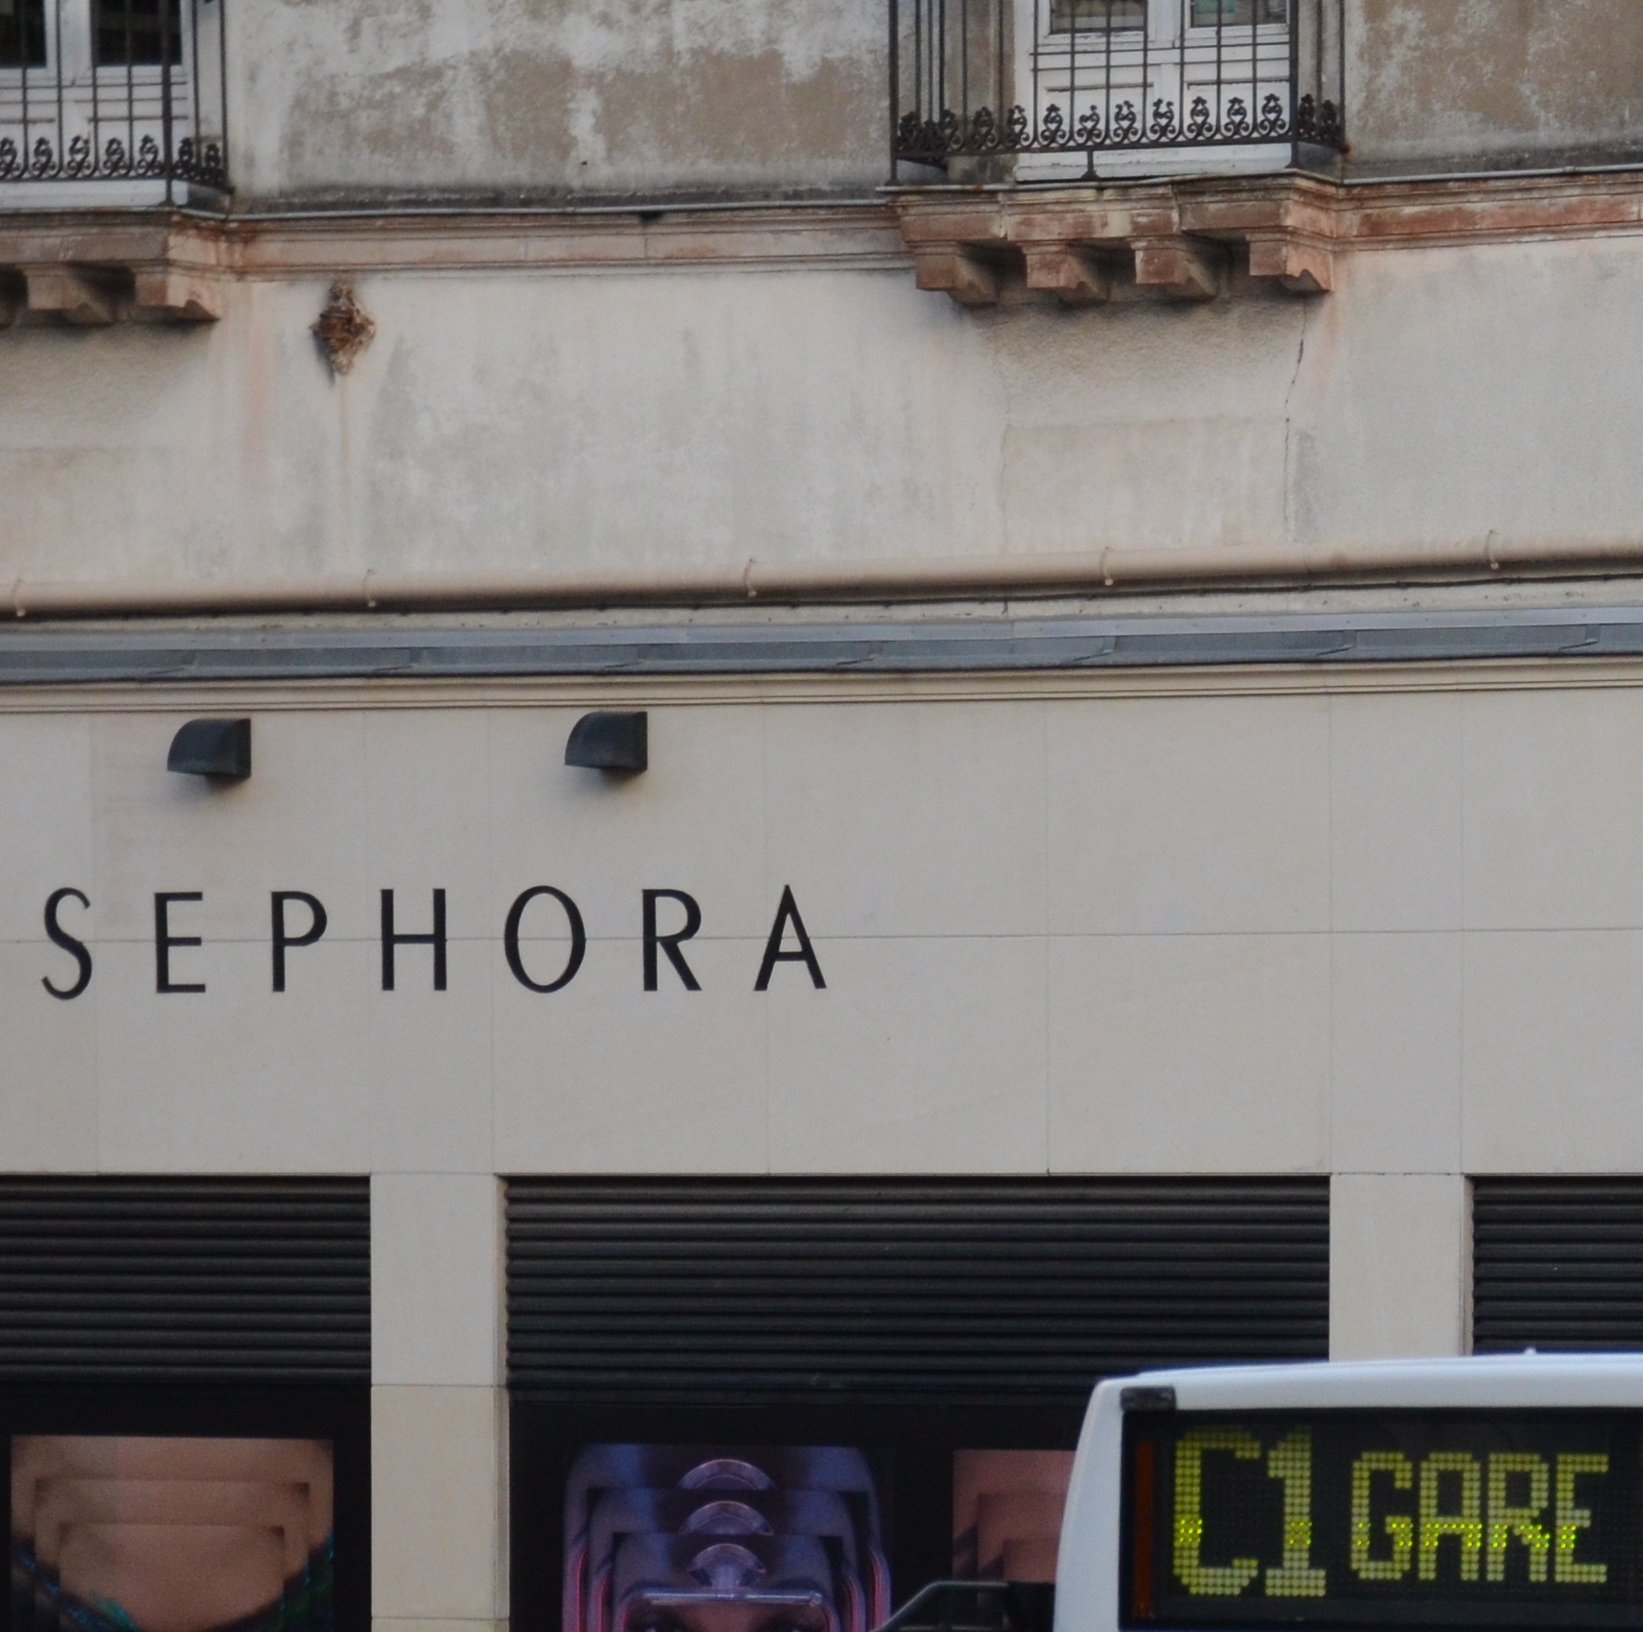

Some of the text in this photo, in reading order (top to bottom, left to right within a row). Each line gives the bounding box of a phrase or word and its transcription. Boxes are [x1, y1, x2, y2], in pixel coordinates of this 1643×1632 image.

[42, 885, 827, 1001] SEPHORA
[1172, 1426, 1328, 1598] C1
[1351, 1449, 1610, 1585] GARE
